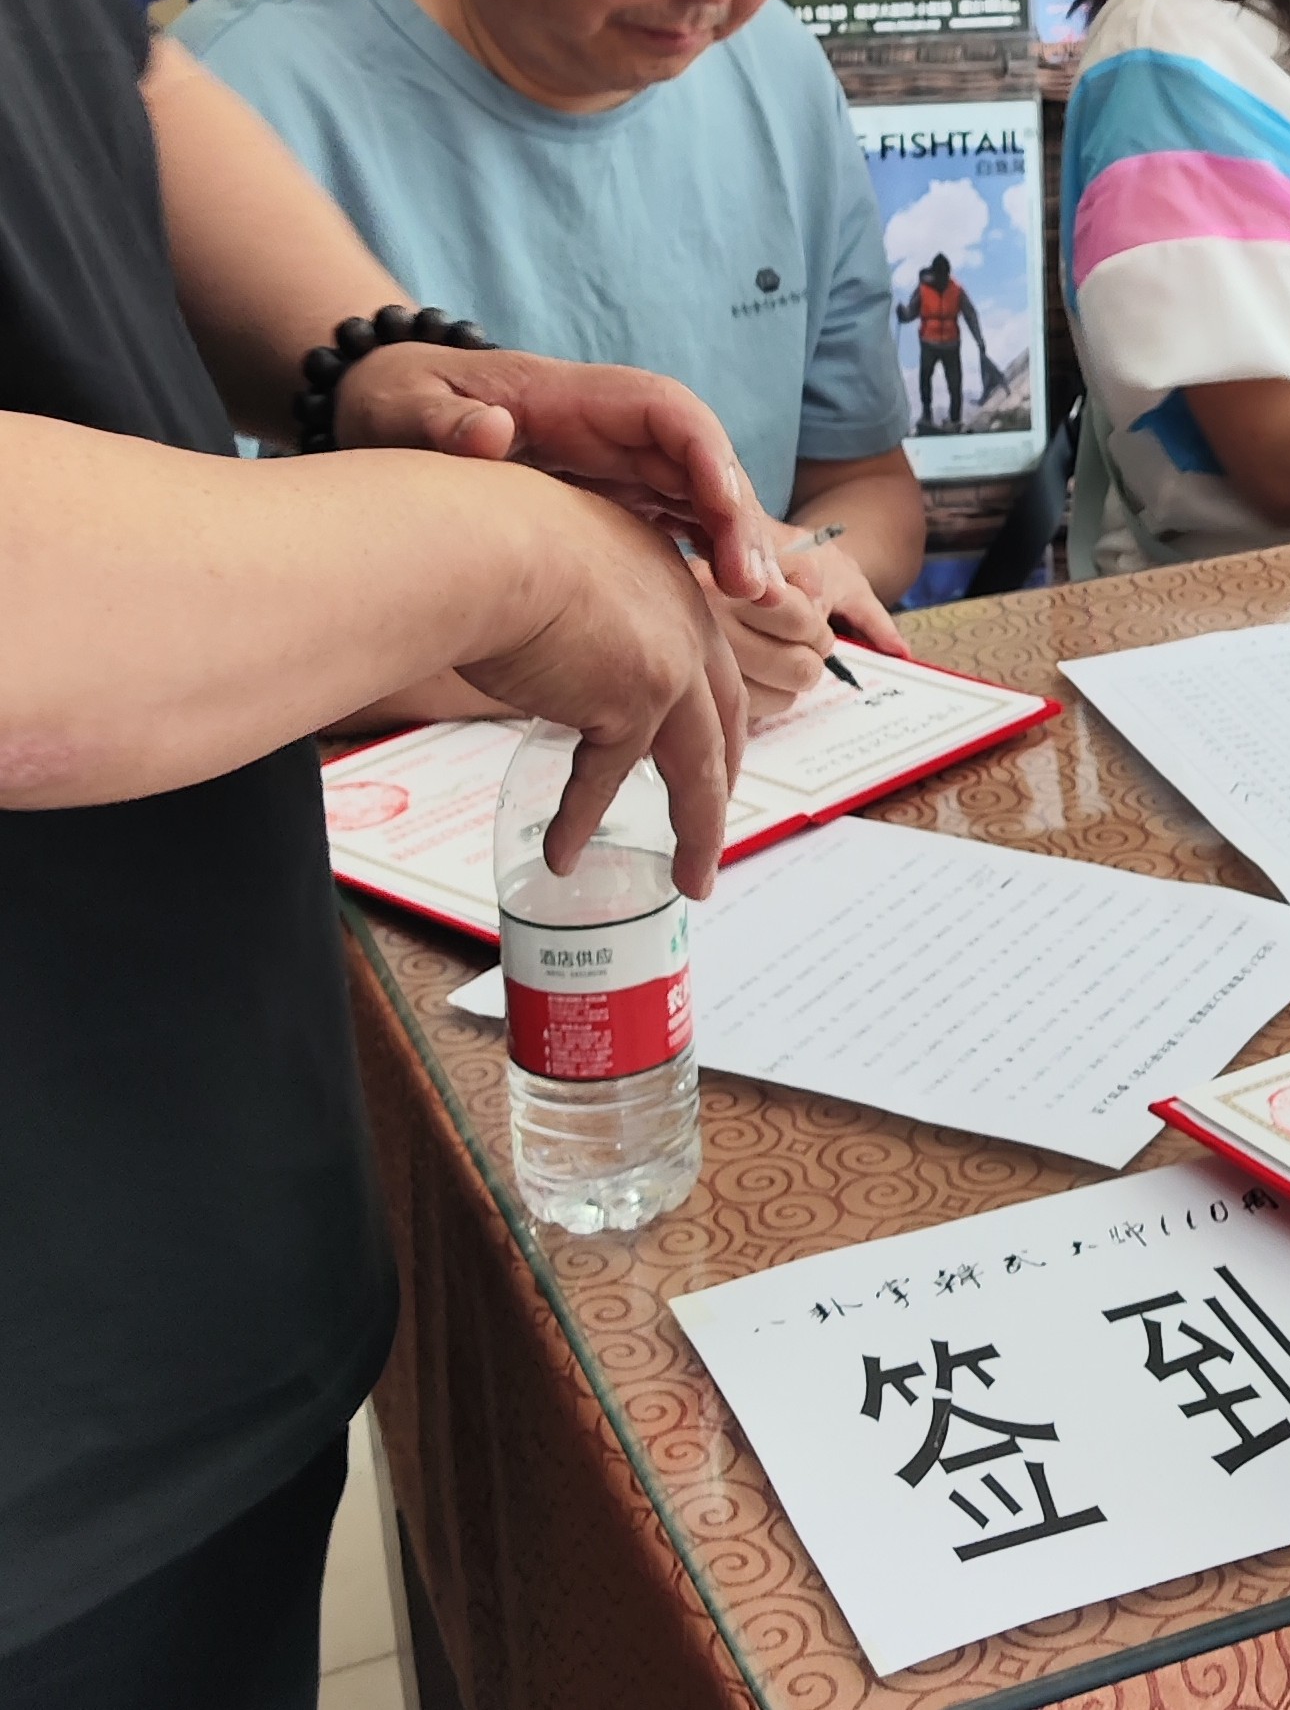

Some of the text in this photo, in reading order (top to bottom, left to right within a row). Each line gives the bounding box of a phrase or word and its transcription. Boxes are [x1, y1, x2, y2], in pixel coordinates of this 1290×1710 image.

[879, 129, 1025, 161] FISHTAIL
[539, 947, 614, 969] 酒店供应
